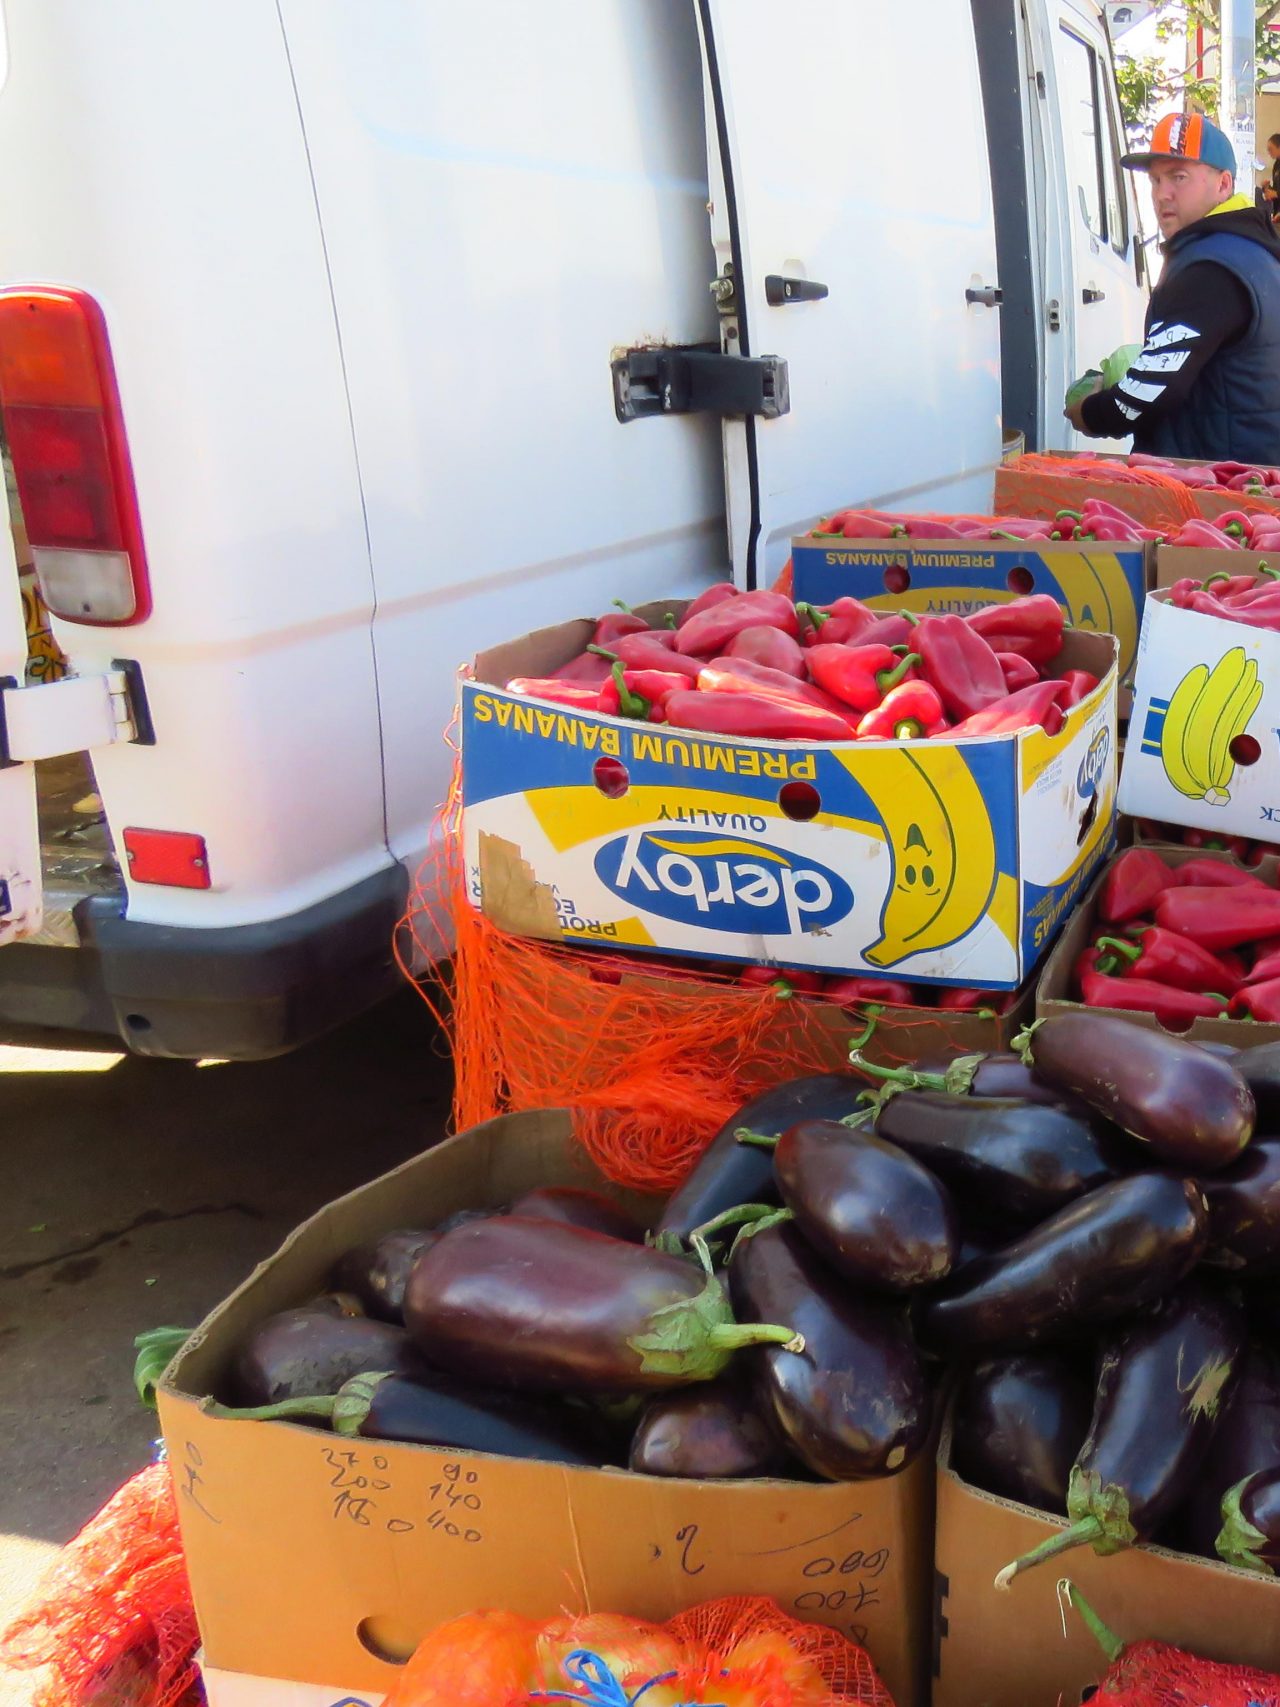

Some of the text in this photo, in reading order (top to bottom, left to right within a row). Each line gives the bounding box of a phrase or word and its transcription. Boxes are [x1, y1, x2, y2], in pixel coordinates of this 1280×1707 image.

[825, 553, 995, 569] PREMIUM BANANAS
[473, 693, 818, 780] PREMIUM BANANAS
[658, 803, 767, 833] QUALITY
[615, 829, 834, 936] derby
